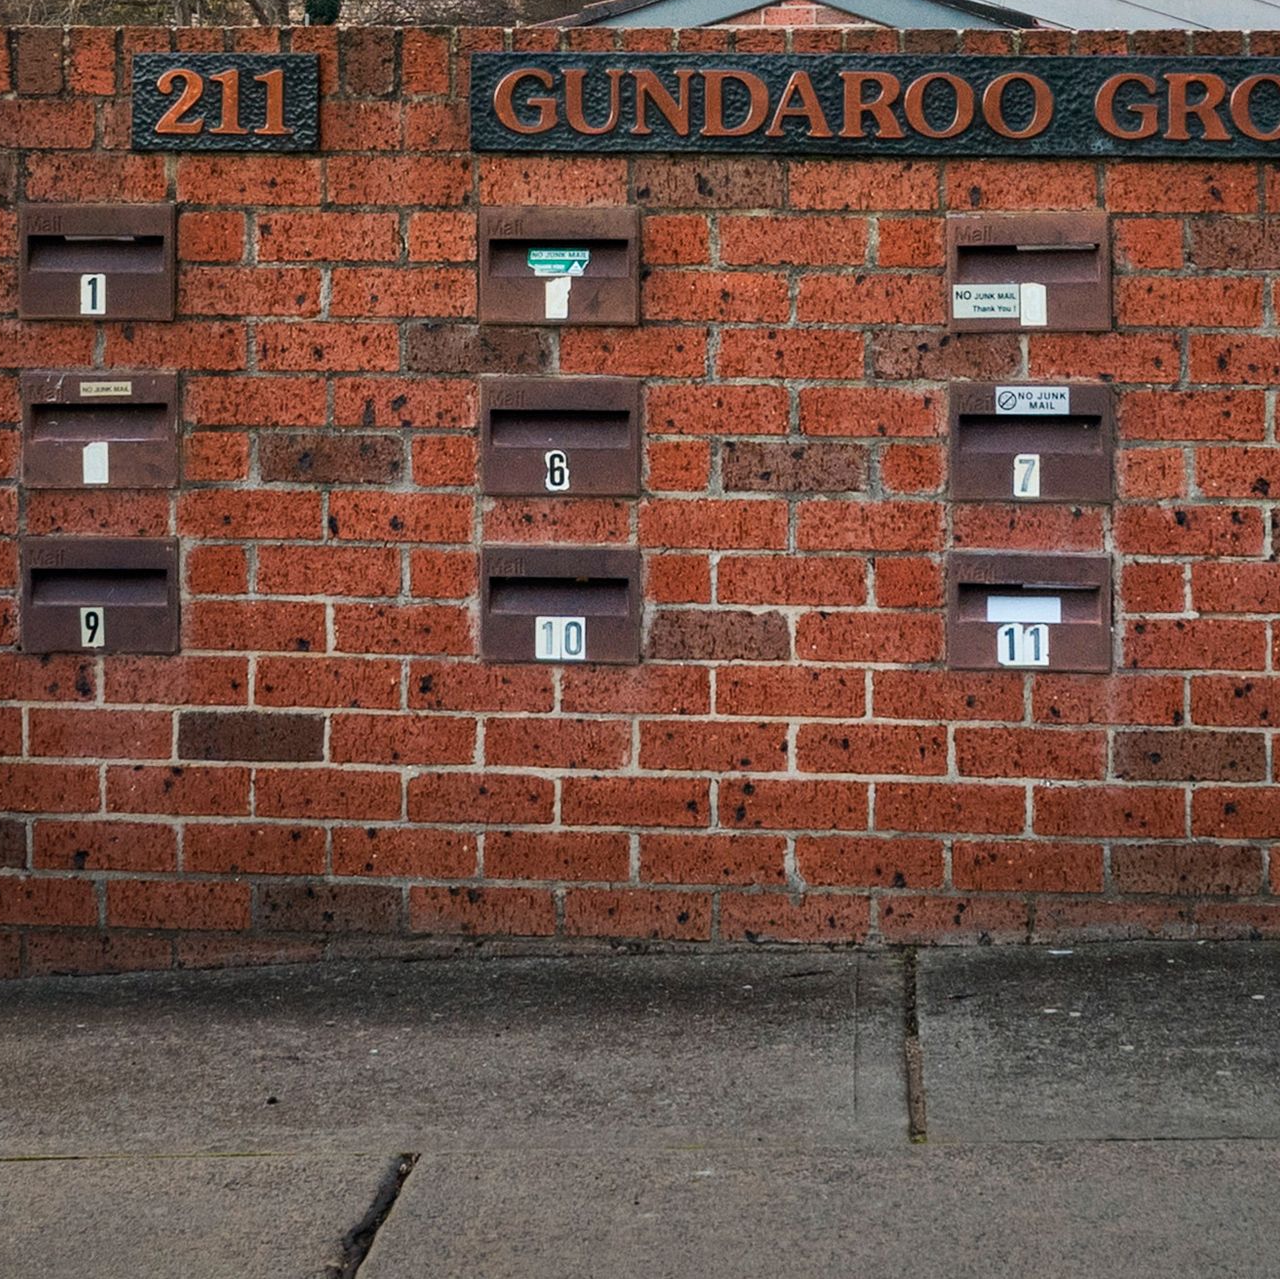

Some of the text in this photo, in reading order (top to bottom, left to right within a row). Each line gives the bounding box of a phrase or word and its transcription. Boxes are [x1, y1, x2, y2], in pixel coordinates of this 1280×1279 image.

[154, 68, 295, 135] 211
[493, 67, 1055, 140] GUNDAROO
[954, 225, 993, 243] Mail
[531, 251, 544, 259] NO
[88, 277, 97, 310] 1
[955, 290, 971, 300] NO
[973, 305, 995, 313] Thank
[998, 305, 1012, 313] You
[1018, 391, 1066, 400] NO JUNK
[1029, 401, 1056, 410] MAIL
[549, 453, 565, 486] 6
[1018, 459, 1036, 492] 7
[85, 611, 99, 643] 9
[542, 621, 583, 656] 10
[1004, 627, 1041, 661] 11
